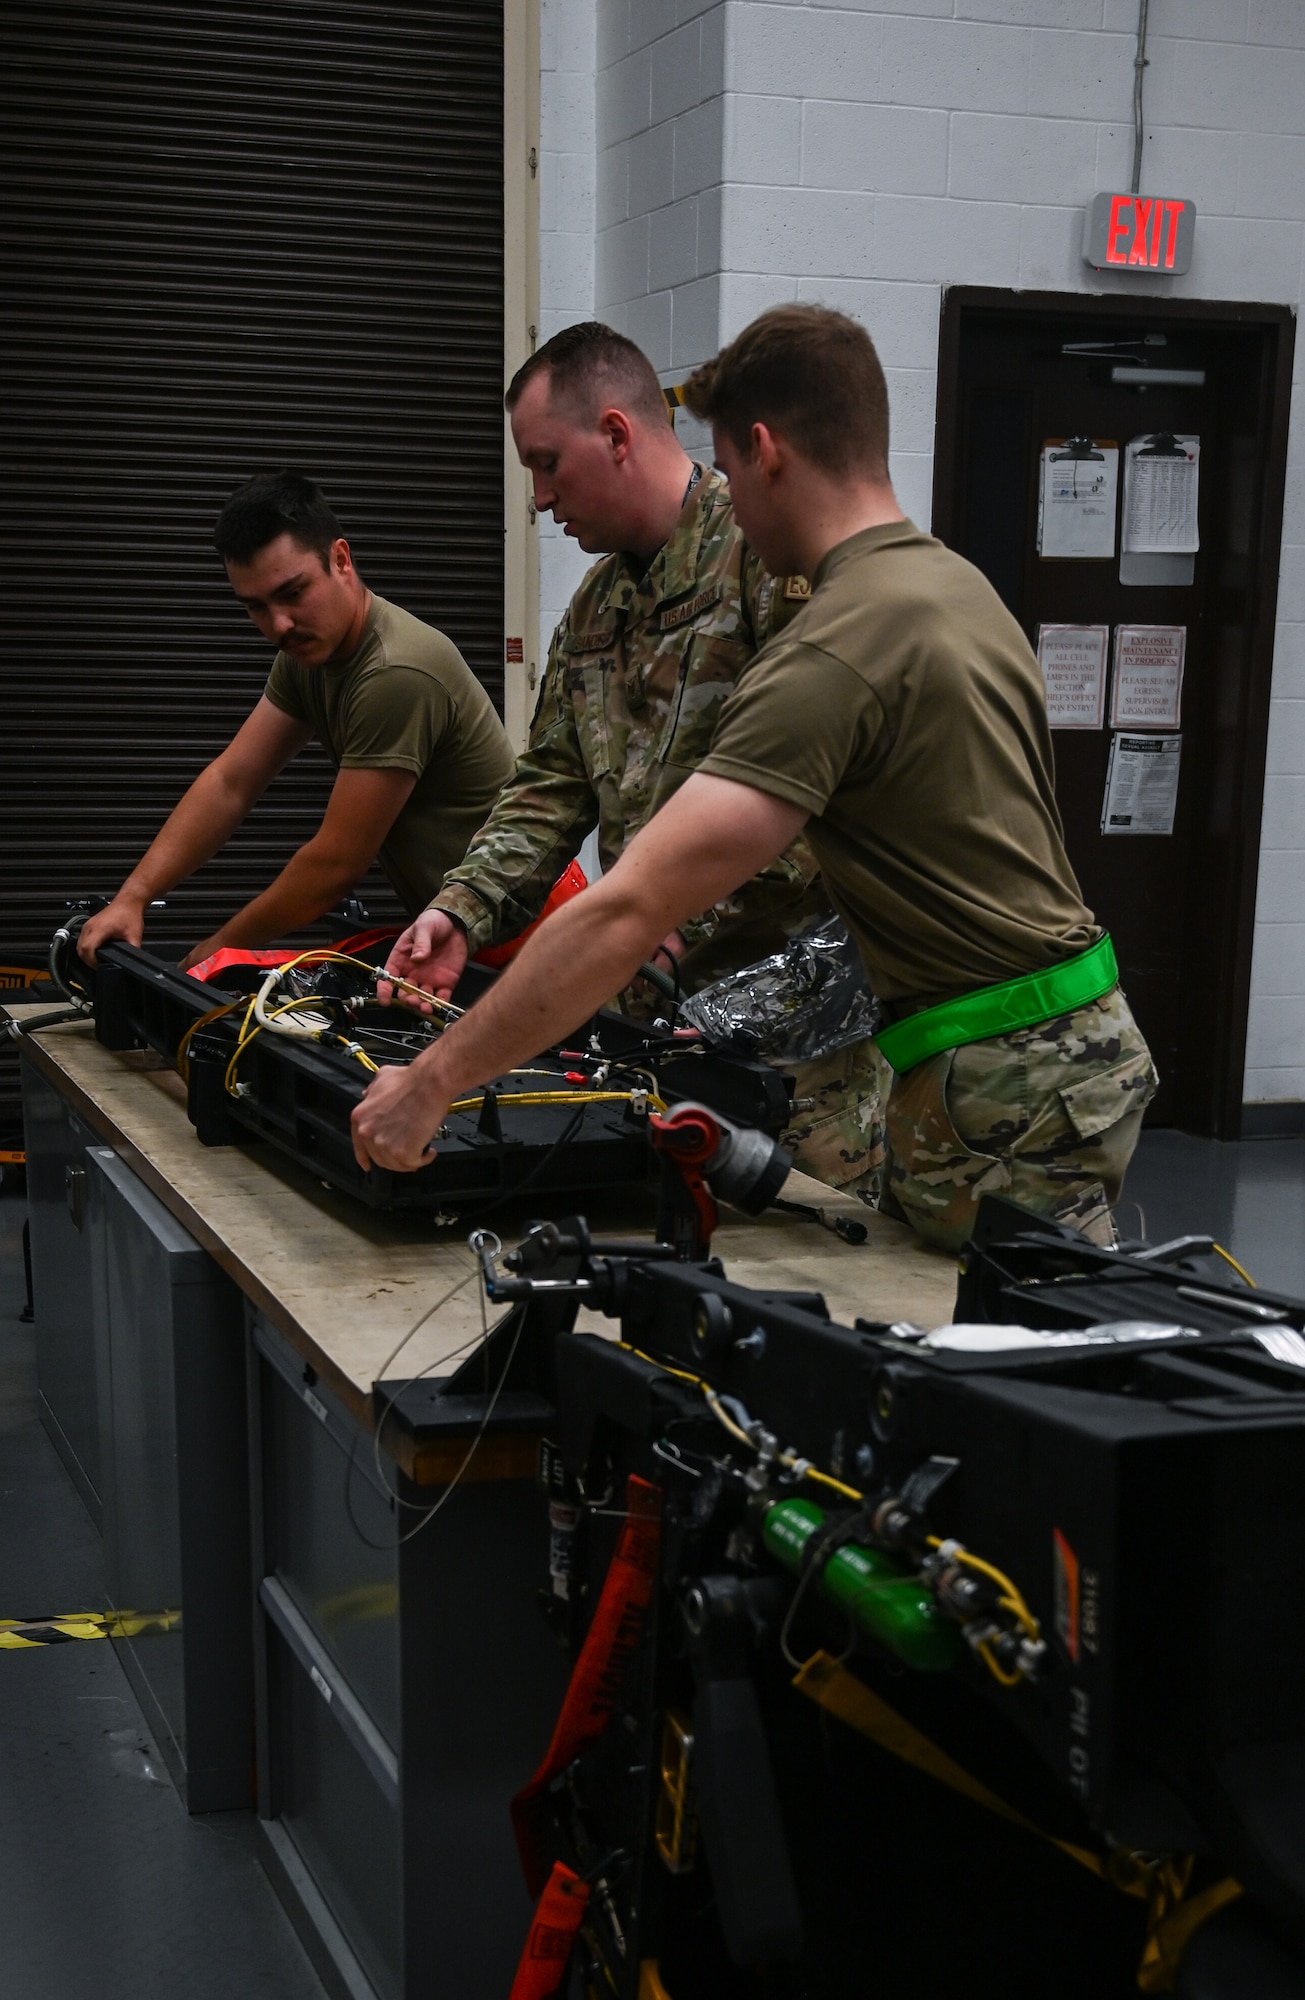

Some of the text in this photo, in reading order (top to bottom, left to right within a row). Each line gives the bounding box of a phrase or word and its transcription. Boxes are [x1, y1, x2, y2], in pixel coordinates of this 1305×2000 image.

[1106, 195, 1185, 268] EXIT
[680, 601, 693, 620] AIR
[694, 586, 716, 612] FORCE
[1131, 636, 1173, 645] EXPLOSIVE
[1046, 642, 1099, 651] PLEASE PLACE
[1122, 646, 1178, 655] MAINTENANCE
[1055, 653, 1089, 661] ALL CELL
[1125, 656, 1176, 665] IN PROGRESS
[1048, 663, 1077, 671] PHONES
[1080, 674, 1095, 682] THE
[1150, 677, 1163, 685] SEE
[1054, 683, 1086, 691] SECTION
[1134, 687, 1161, 695] EGRESS
[1047, 693, 1097, 702] HIEF'S OFFICE
[1125, 697, 1169, 705] SUPERVISOR
[1066, 704, 1094, 712] ENTRY!
[1122, 707, 1143, 715] UPON
